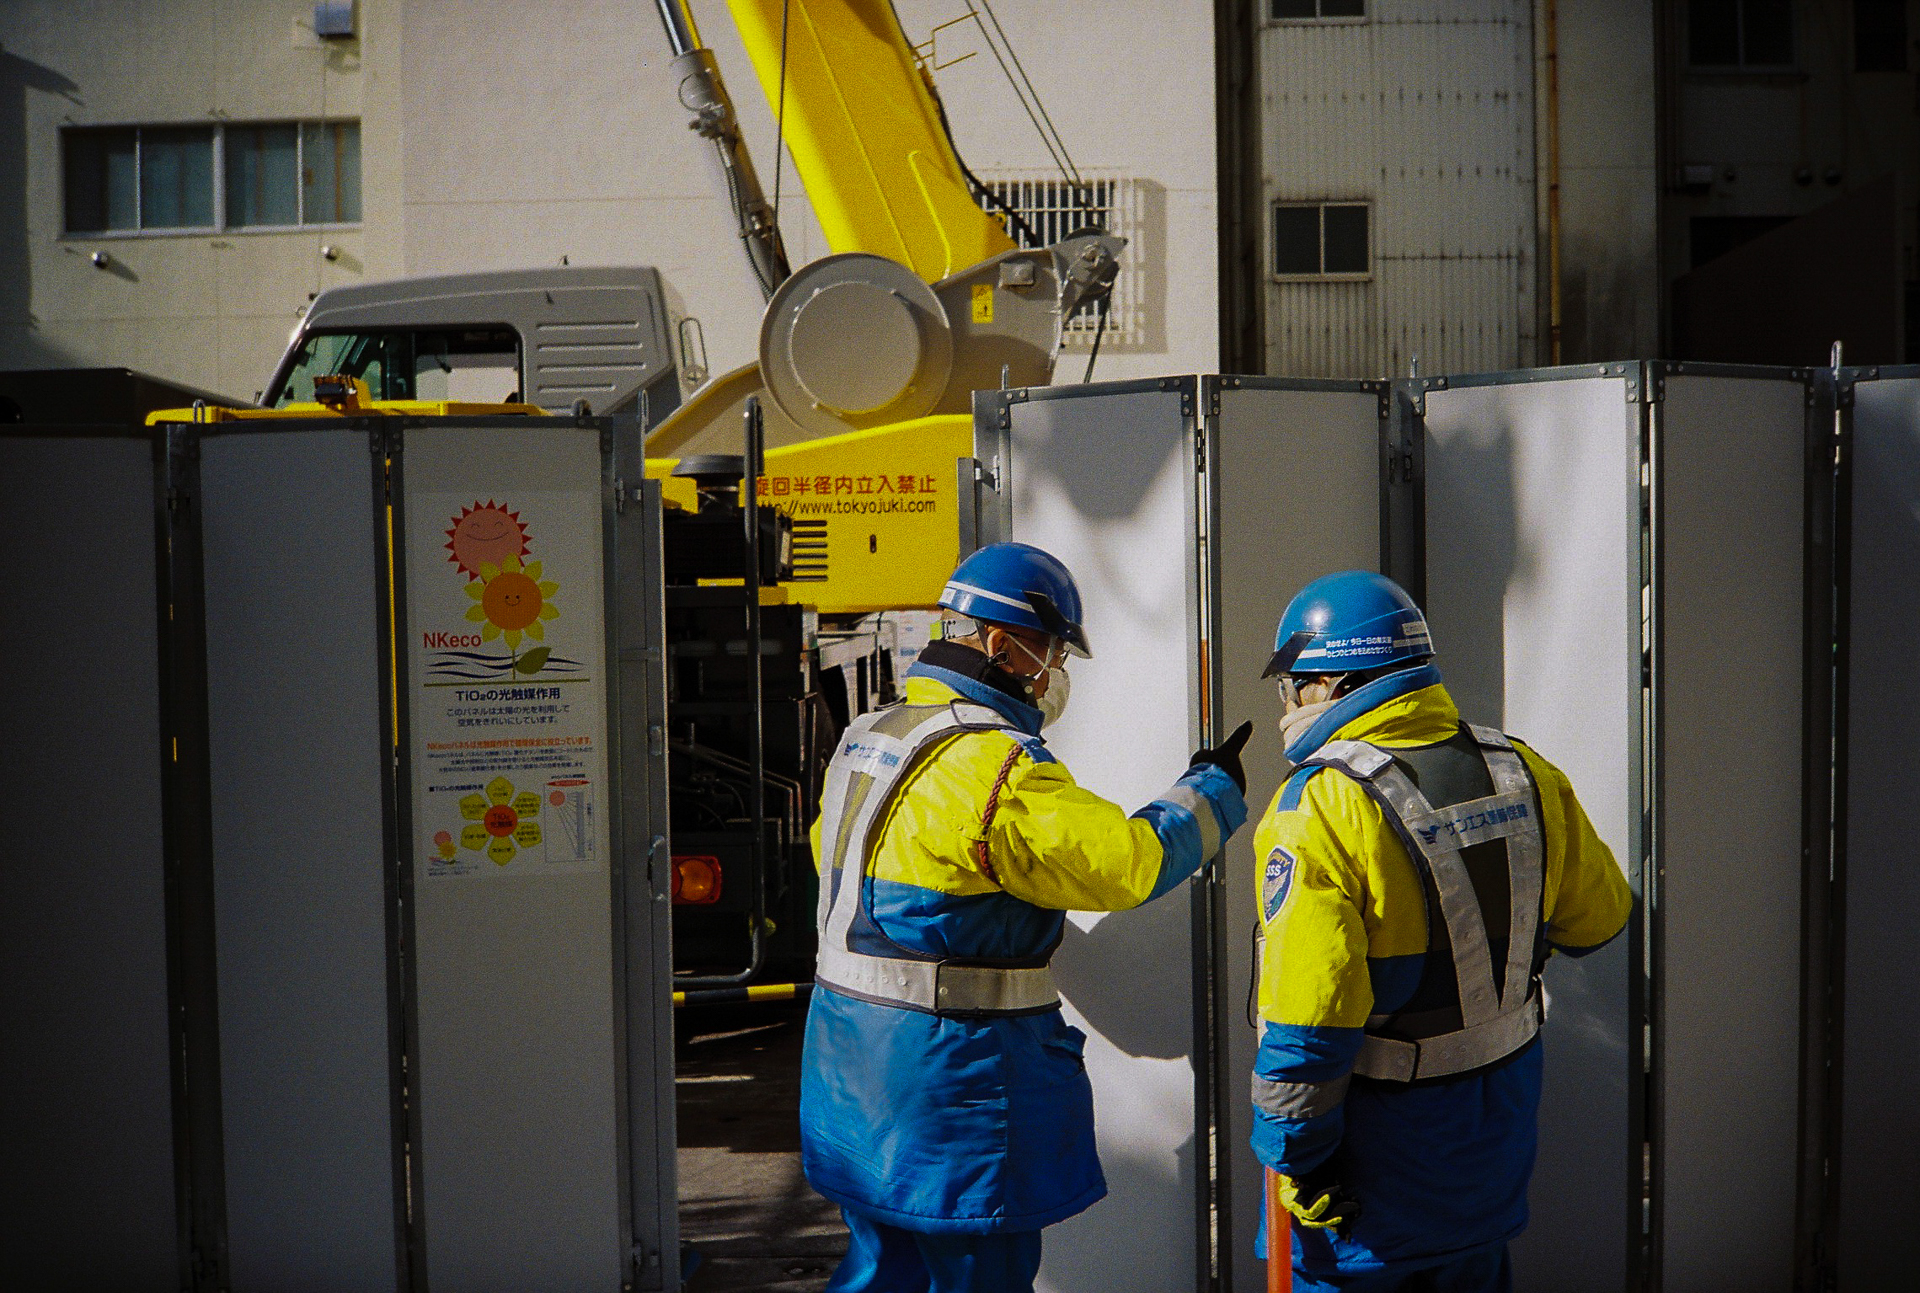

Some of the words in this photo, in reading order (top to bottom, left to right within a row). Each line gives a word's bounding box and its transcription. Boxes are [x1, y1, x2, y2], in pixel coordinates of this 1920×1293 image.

[757, 474, 937, 496] 旋回半径内立入禁止
[423, 632, 482, 648] NKeco
[1443, 803, 1528, 836] サンエス警備保障
[1266, 864, 1281, 877] SSS
